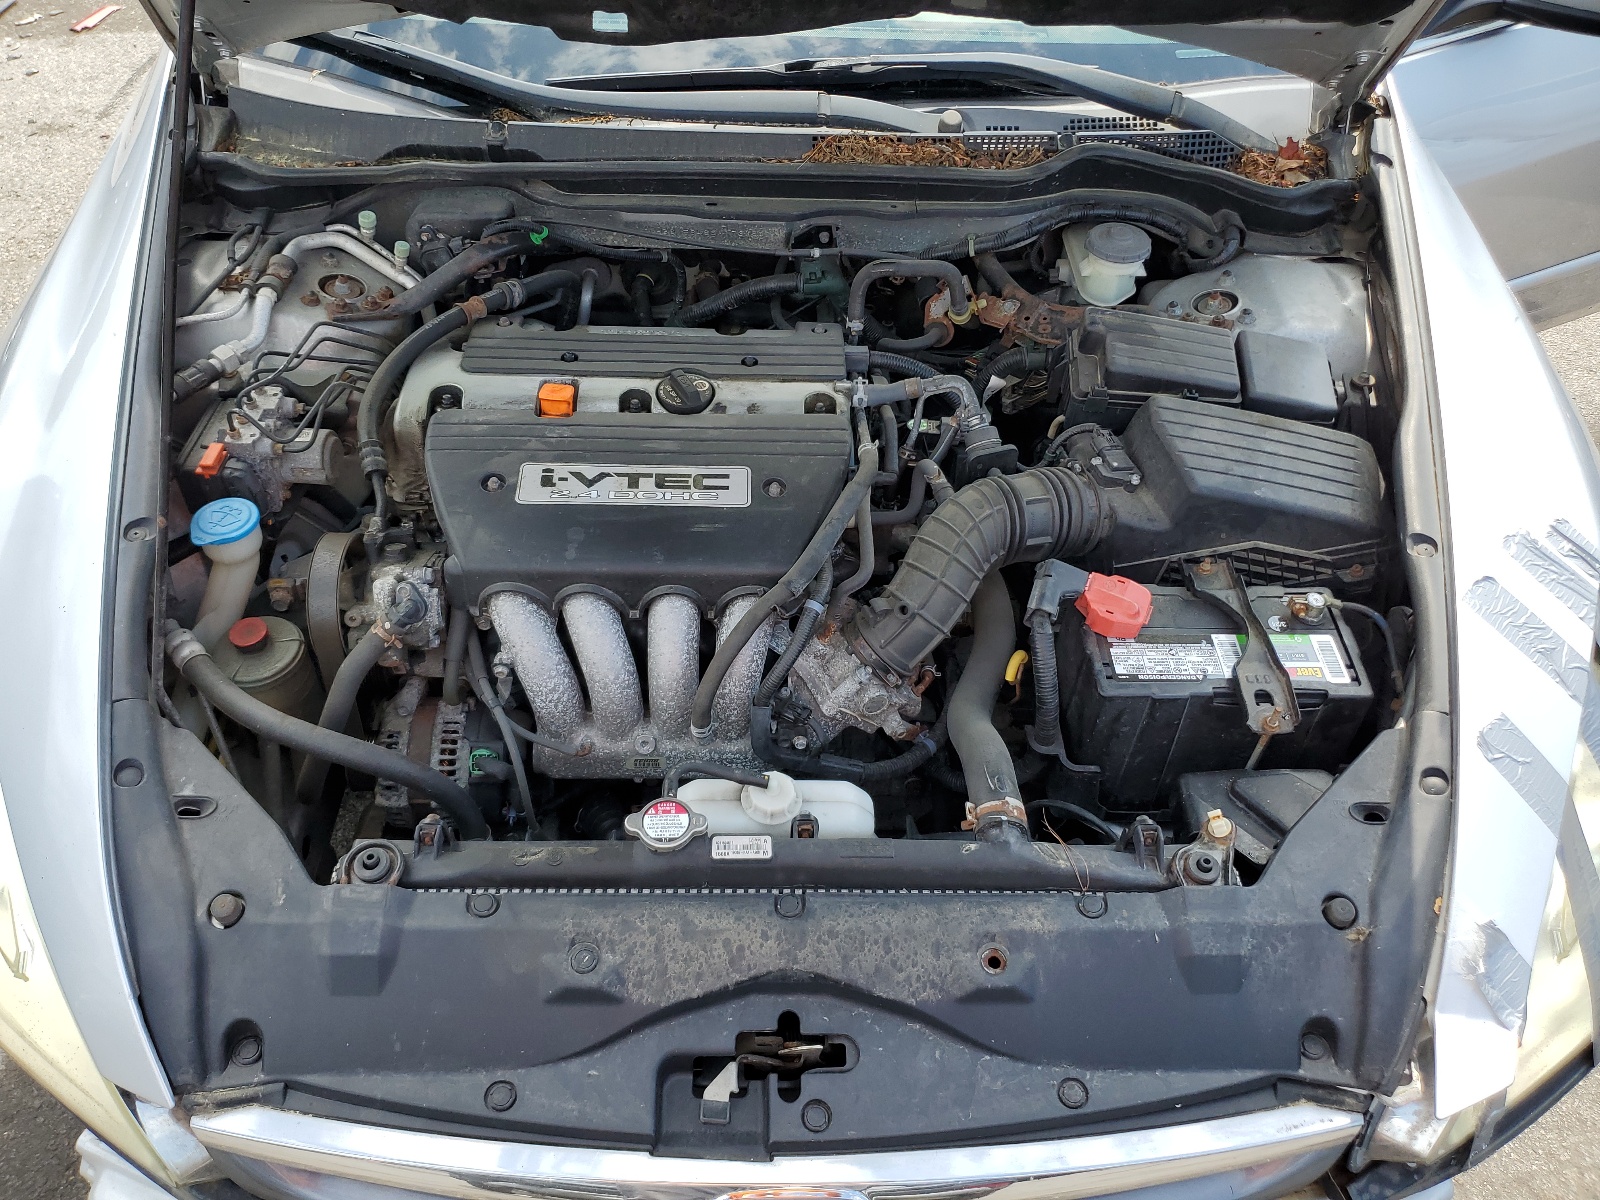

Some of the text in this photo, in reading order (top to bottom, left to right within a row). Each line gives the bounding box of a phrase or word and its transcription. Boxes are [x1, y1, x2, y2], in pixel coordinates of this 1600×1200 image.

[540, 467, 730, 491] i-VTEC
[549, 489, 719, 501] 2.4 DOHC
